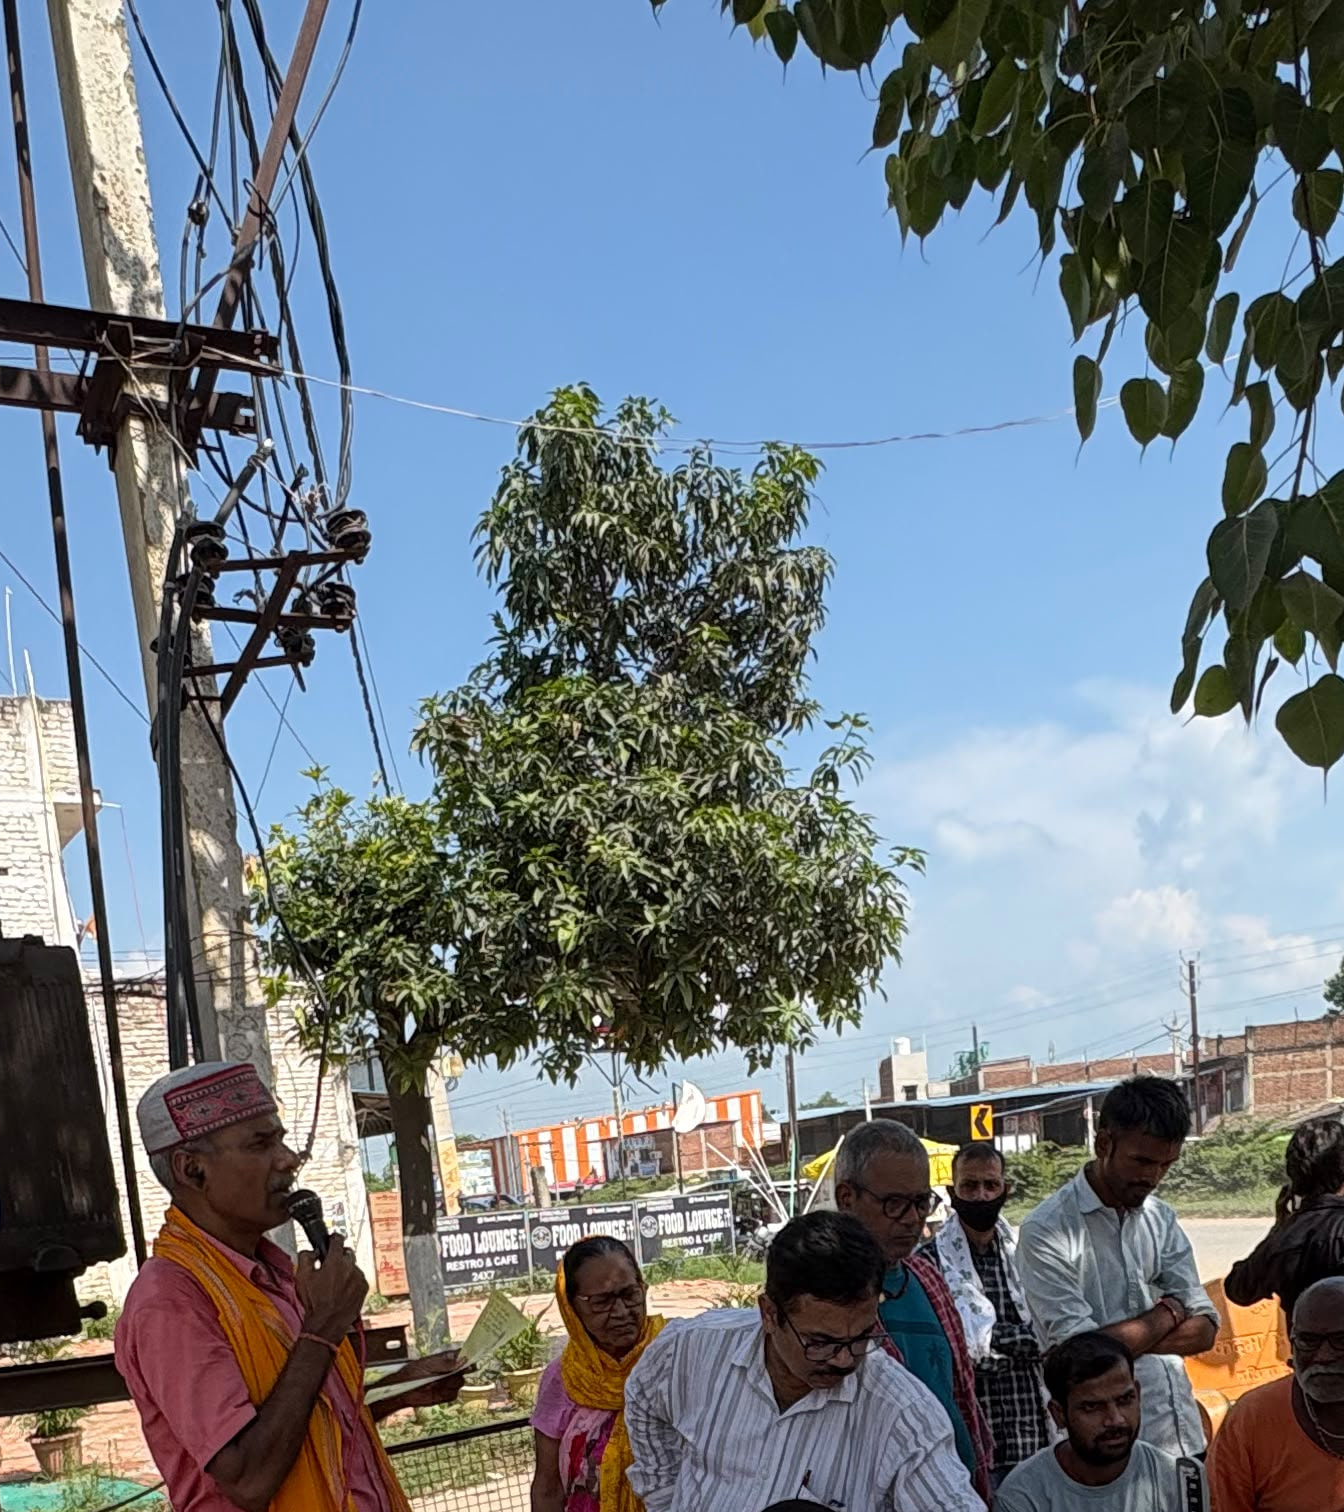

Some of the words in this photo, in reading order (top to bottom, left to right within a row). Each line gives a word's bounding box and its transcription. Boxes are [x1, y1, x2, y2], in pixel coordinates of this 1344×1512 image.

[551, 1221, 581, 1248] FOOD
[657, 1212, 684, 1236] FOOD
[685, 1207, 724, 1232] LOUNGE
[441, 1232, 471, 1258] FOOD
[473, 1228, 519, 1254] LOUNGE
[446, 1258, 484, 1272] RESTRO
[493, 1254, 518, 1267] CAFE
[471, 1270, 496, 1282] 24X7
